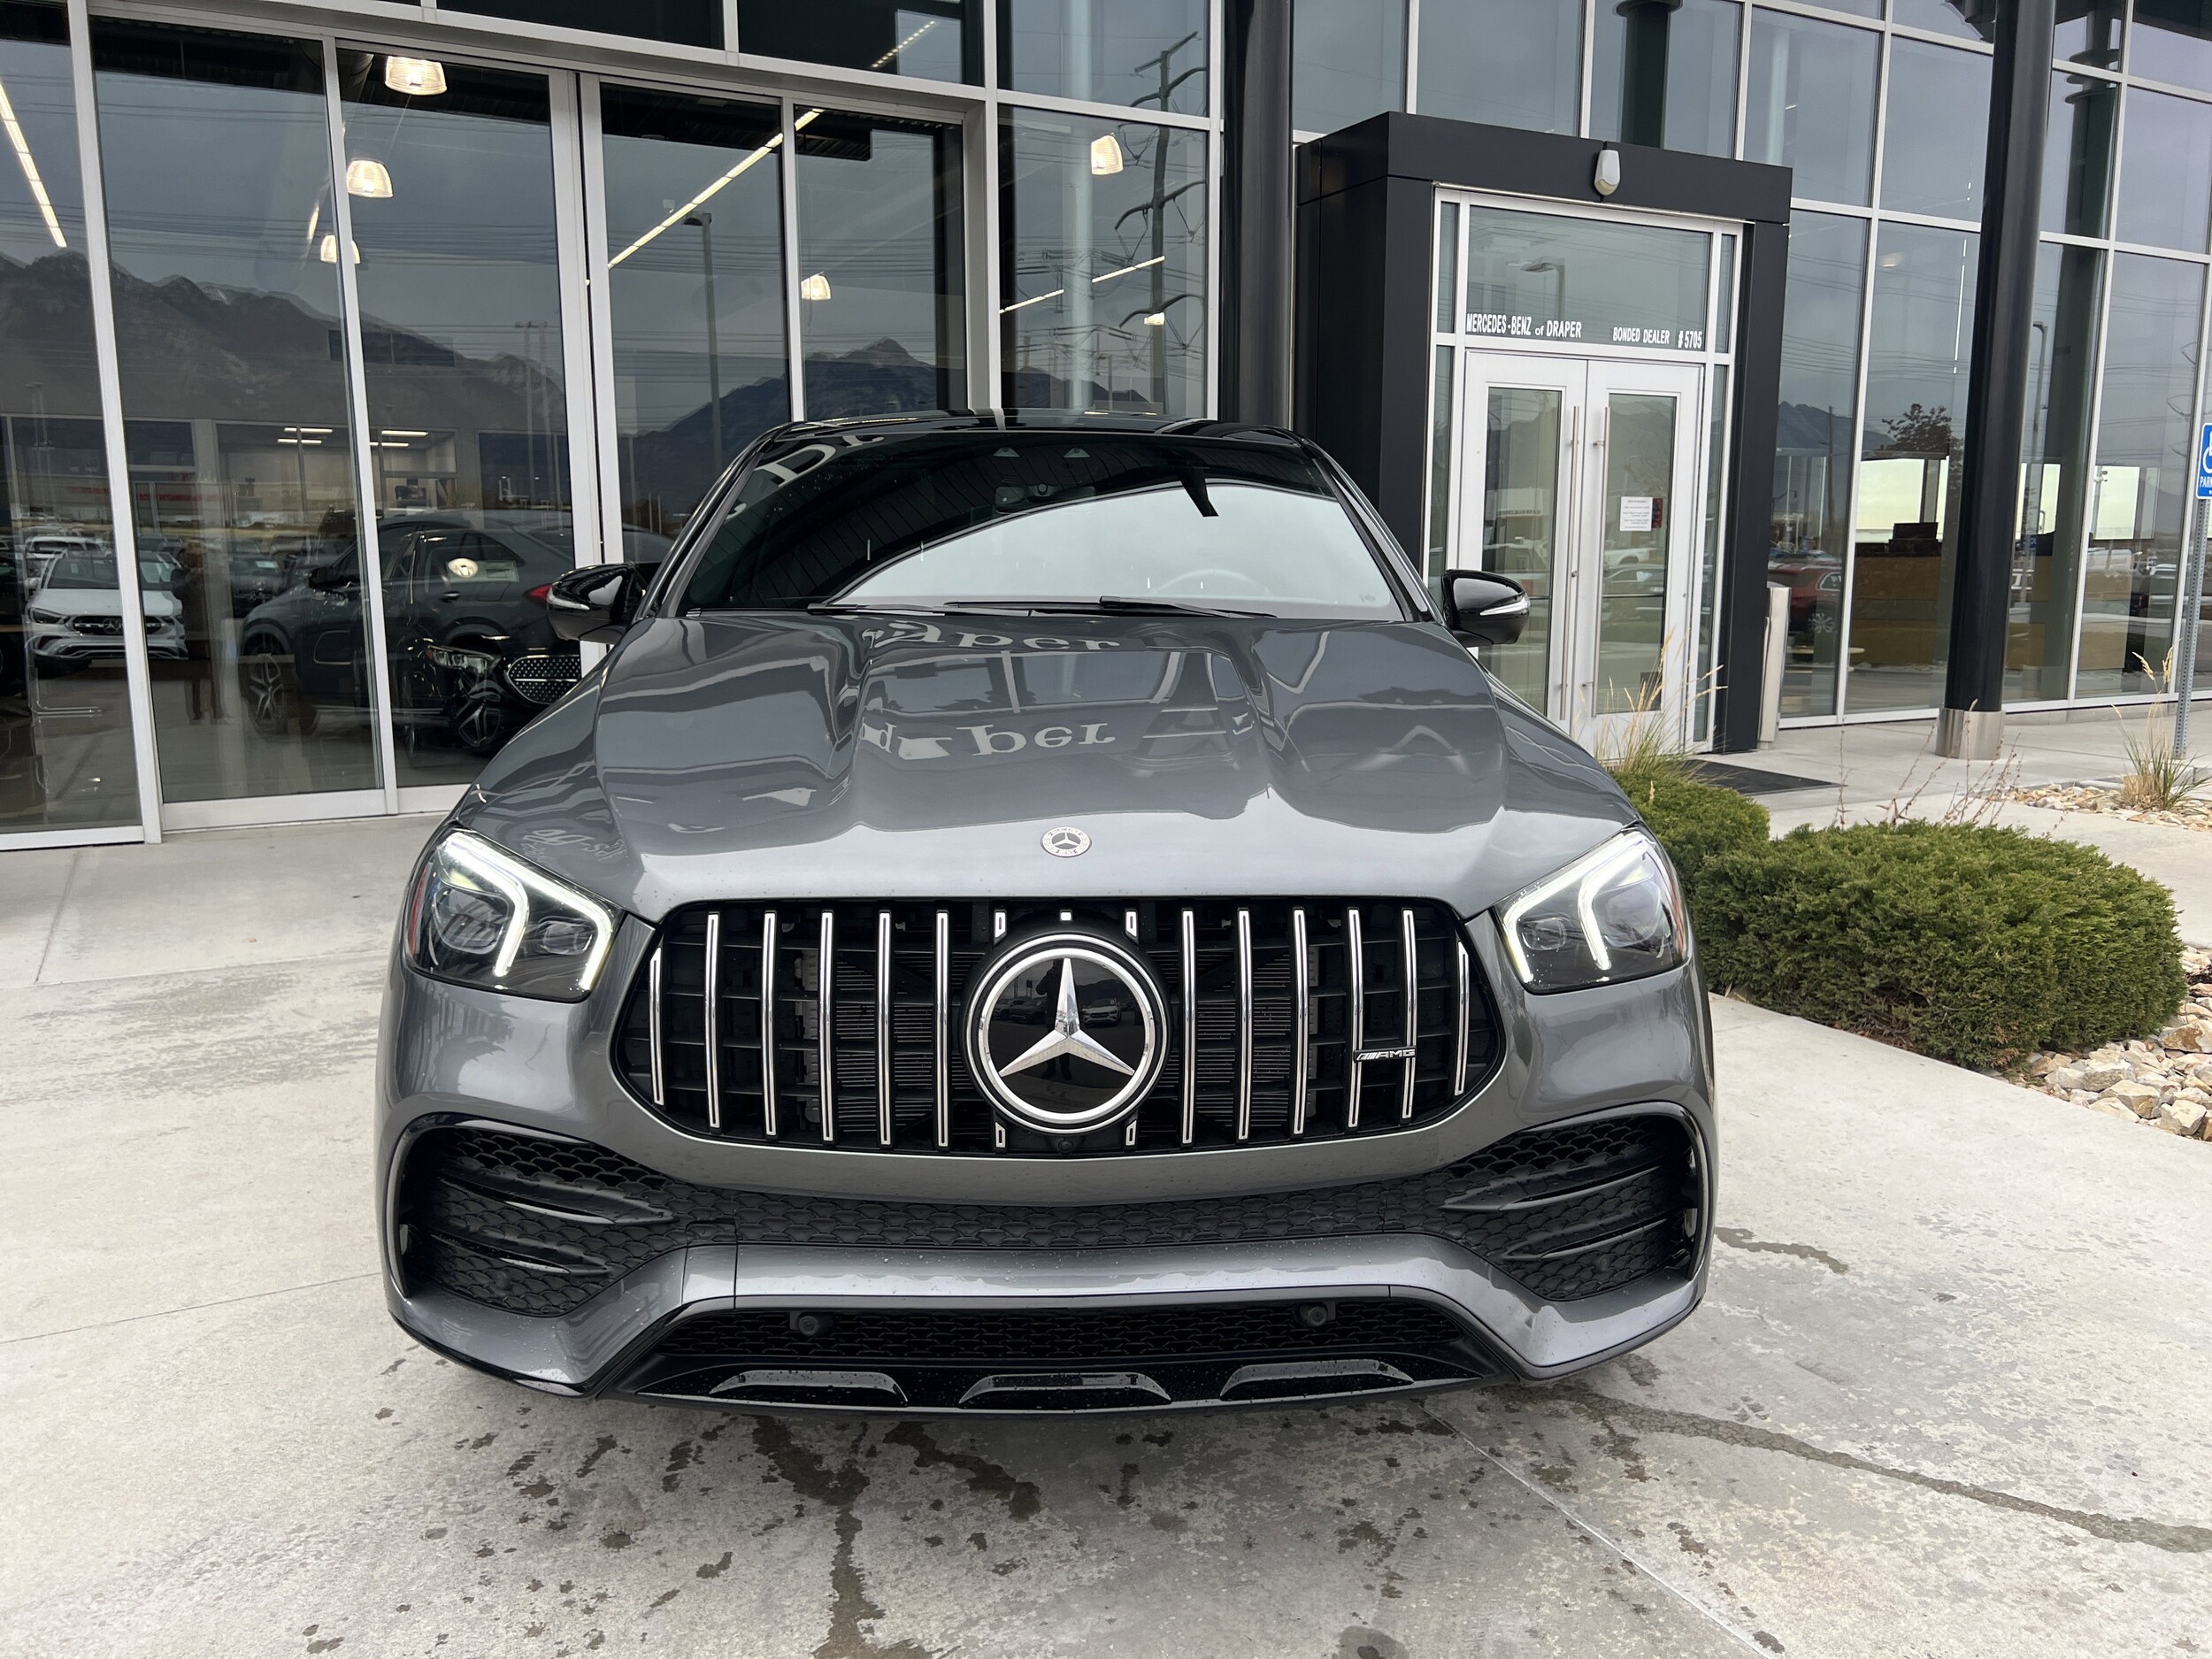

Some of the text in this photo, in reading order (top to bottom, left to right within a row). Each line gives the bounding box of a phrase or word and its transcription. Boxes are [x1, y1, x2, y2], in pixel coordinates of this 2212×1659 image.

[1466, 313, 1582, 338] MERCEDES-BENZ of DRAPER
[1612, 326, 1641, 342] BONDED
[1642, 329, 1671, 344] DEALER
[1375, 1048, 1416, 1059] AMG
